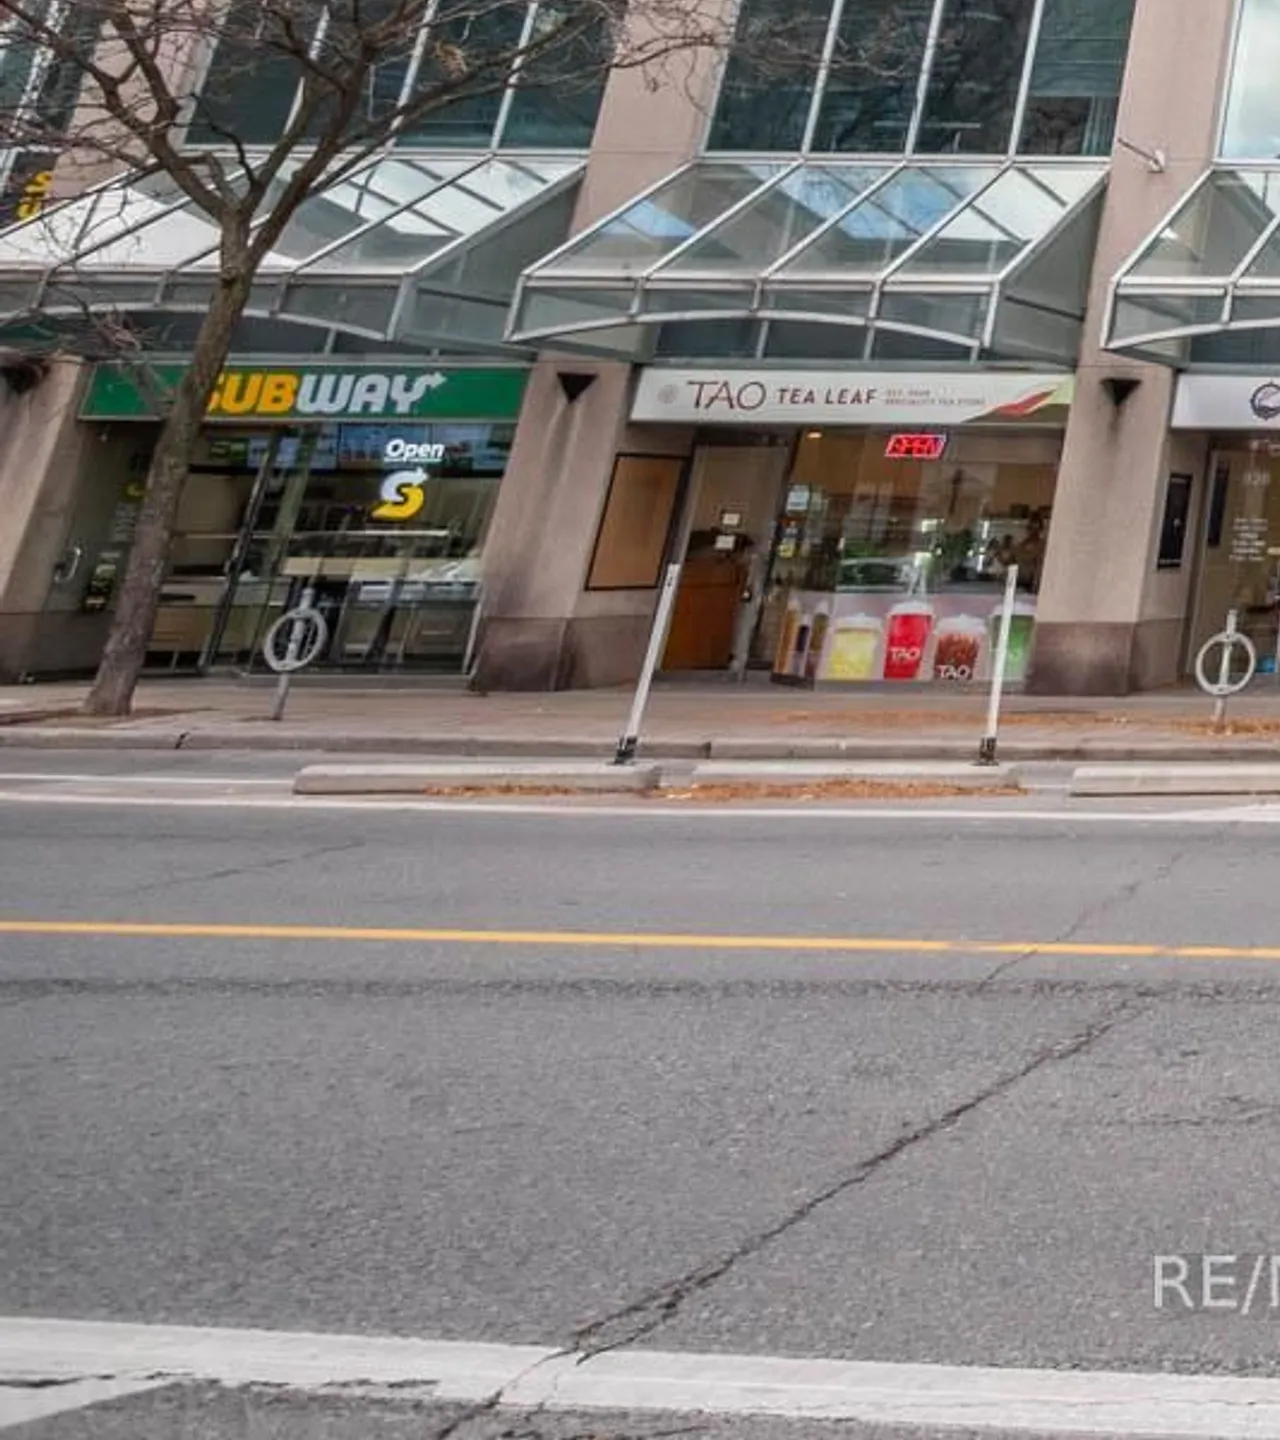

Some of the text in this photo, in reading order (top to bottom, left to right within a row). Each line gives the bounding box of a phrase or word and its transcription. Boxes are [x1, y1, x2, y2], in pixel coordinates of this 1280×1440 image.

[687, 381, 767, 410] TAO
[776, 388, 815, 404] TEA
[824, 388, 878, 404] LEAF
[384, 439, 445, 463] Open
[889, 646, 921, 660] TAO
[937, 664, 970, 678] TAO
